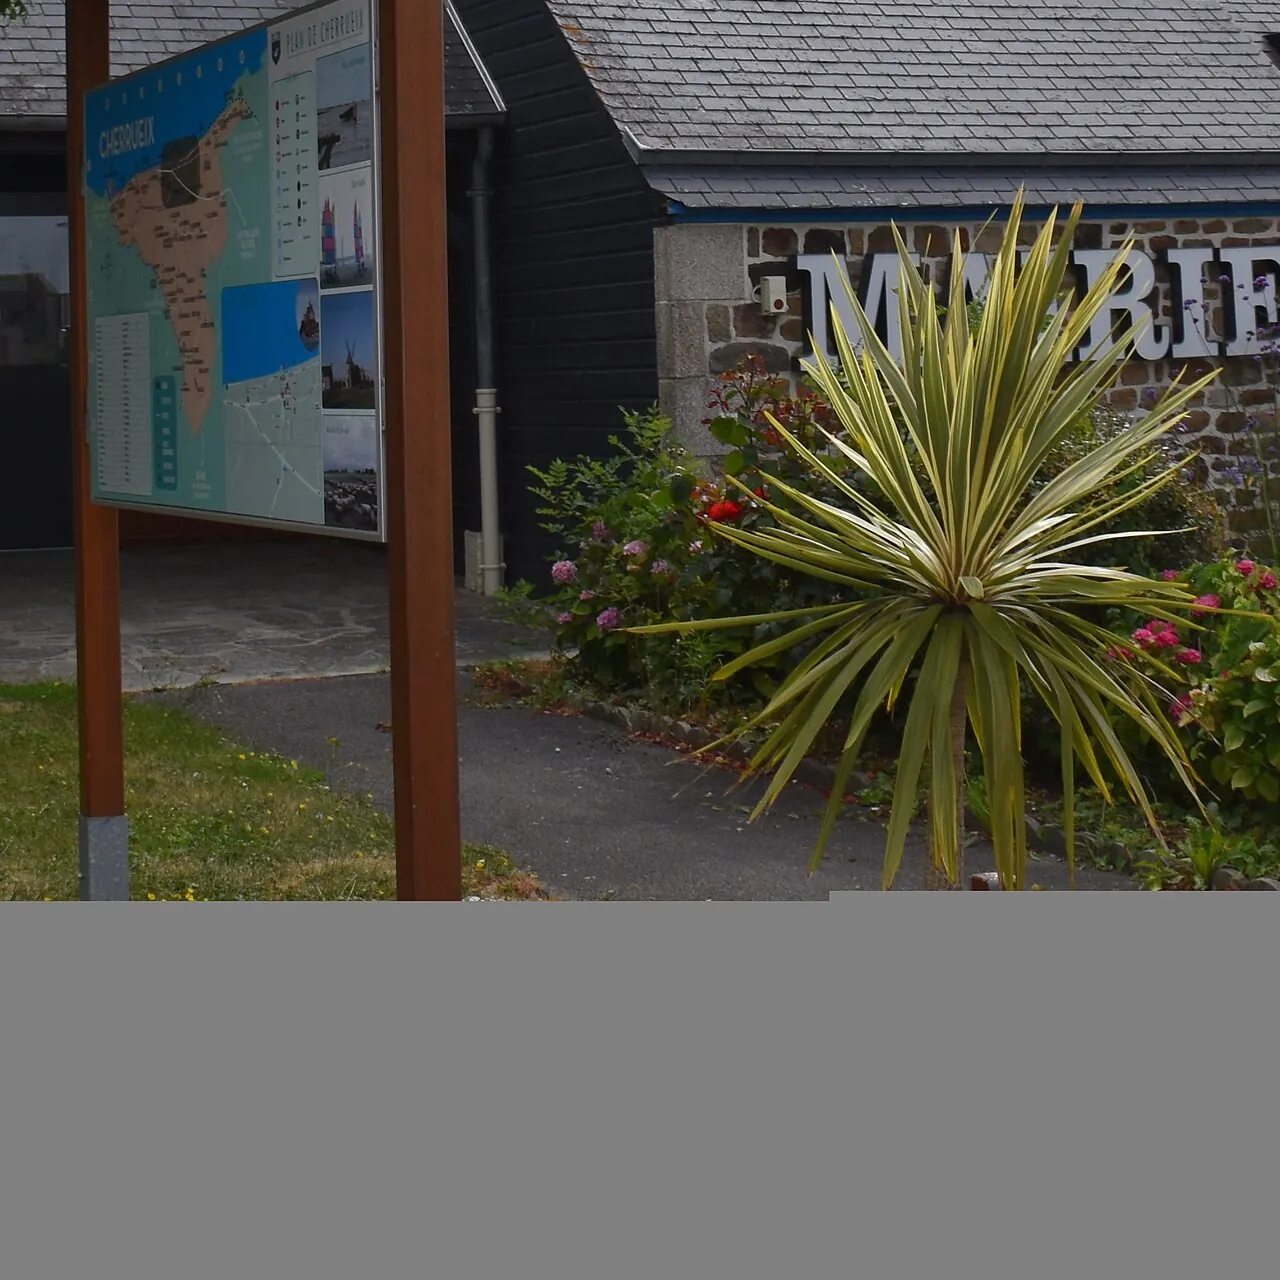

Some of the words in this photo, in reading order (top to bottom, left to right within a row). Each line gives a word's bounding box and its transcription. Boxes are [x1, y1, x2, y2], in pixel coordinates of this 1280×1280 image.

[286, 29, 304, 55] PLAN
[307, 24, 317, 47] DE
[320, 9, 364, 43] CHERRUEIX
[99, 115, 156, 159] CHERRUEIX
